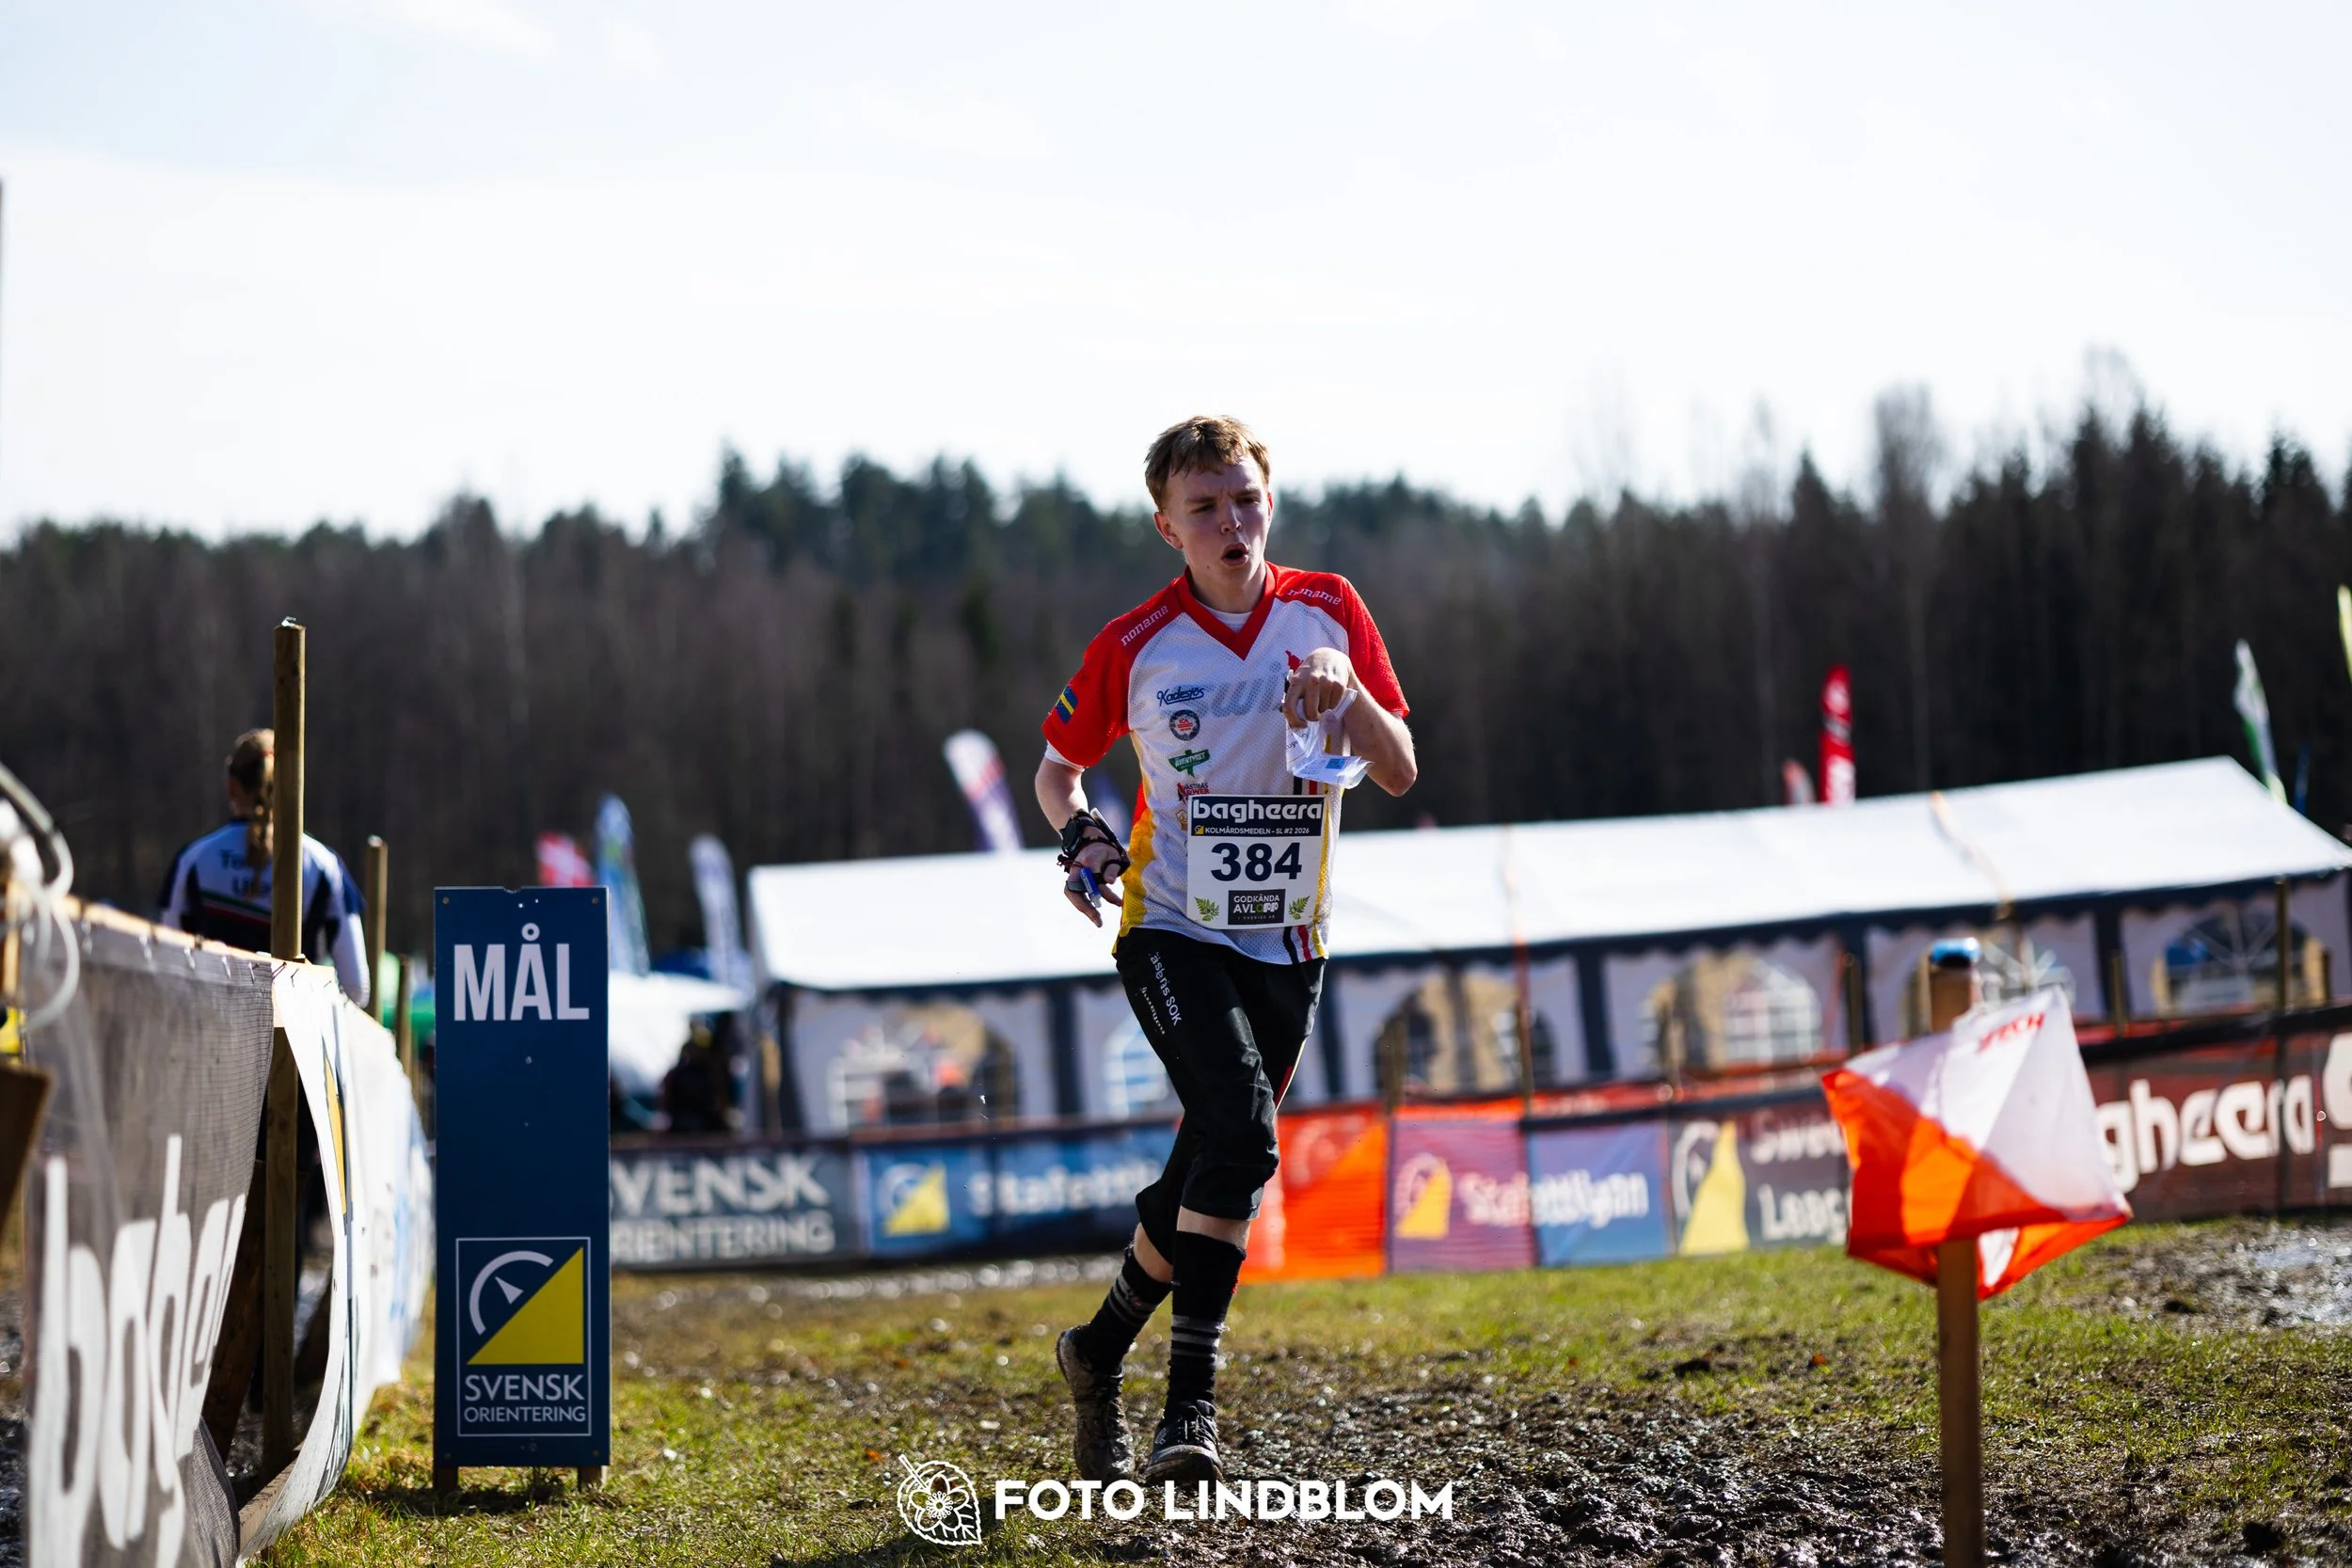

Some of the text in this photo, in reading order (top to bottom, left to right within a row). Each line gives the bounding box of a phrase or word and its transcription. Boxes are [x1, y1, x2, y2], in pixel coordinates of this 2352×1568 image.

[1120, 605, 1169, 646] noname
[1156, 687, 1205, 706] Kadesjös
[1192, 799, 1323, 824] bagheera
[1204, 825, 1271, 835] KOLMÅRDSMEDELN
[1295, 827, 1311, 835] 2026
[1211, 841, 1303, 882] 384
[1232, 901, 1279, 914] AVLOPP
[1233, 894, 1280, 903] GODKÄNDA
[453, 922, 590, 1022] MÅL
[1166, 995, 1182, 1026] SOK
[2096, 1074, 2315, 1194] gheera
[610, 1152, 832, 1218] VENSK
[610, 1210, 835, 1264] RIENTERING
[464, 1373, 585, 1402] SVENSK
[463, 1405, 586, 1423] ORIENTERING
